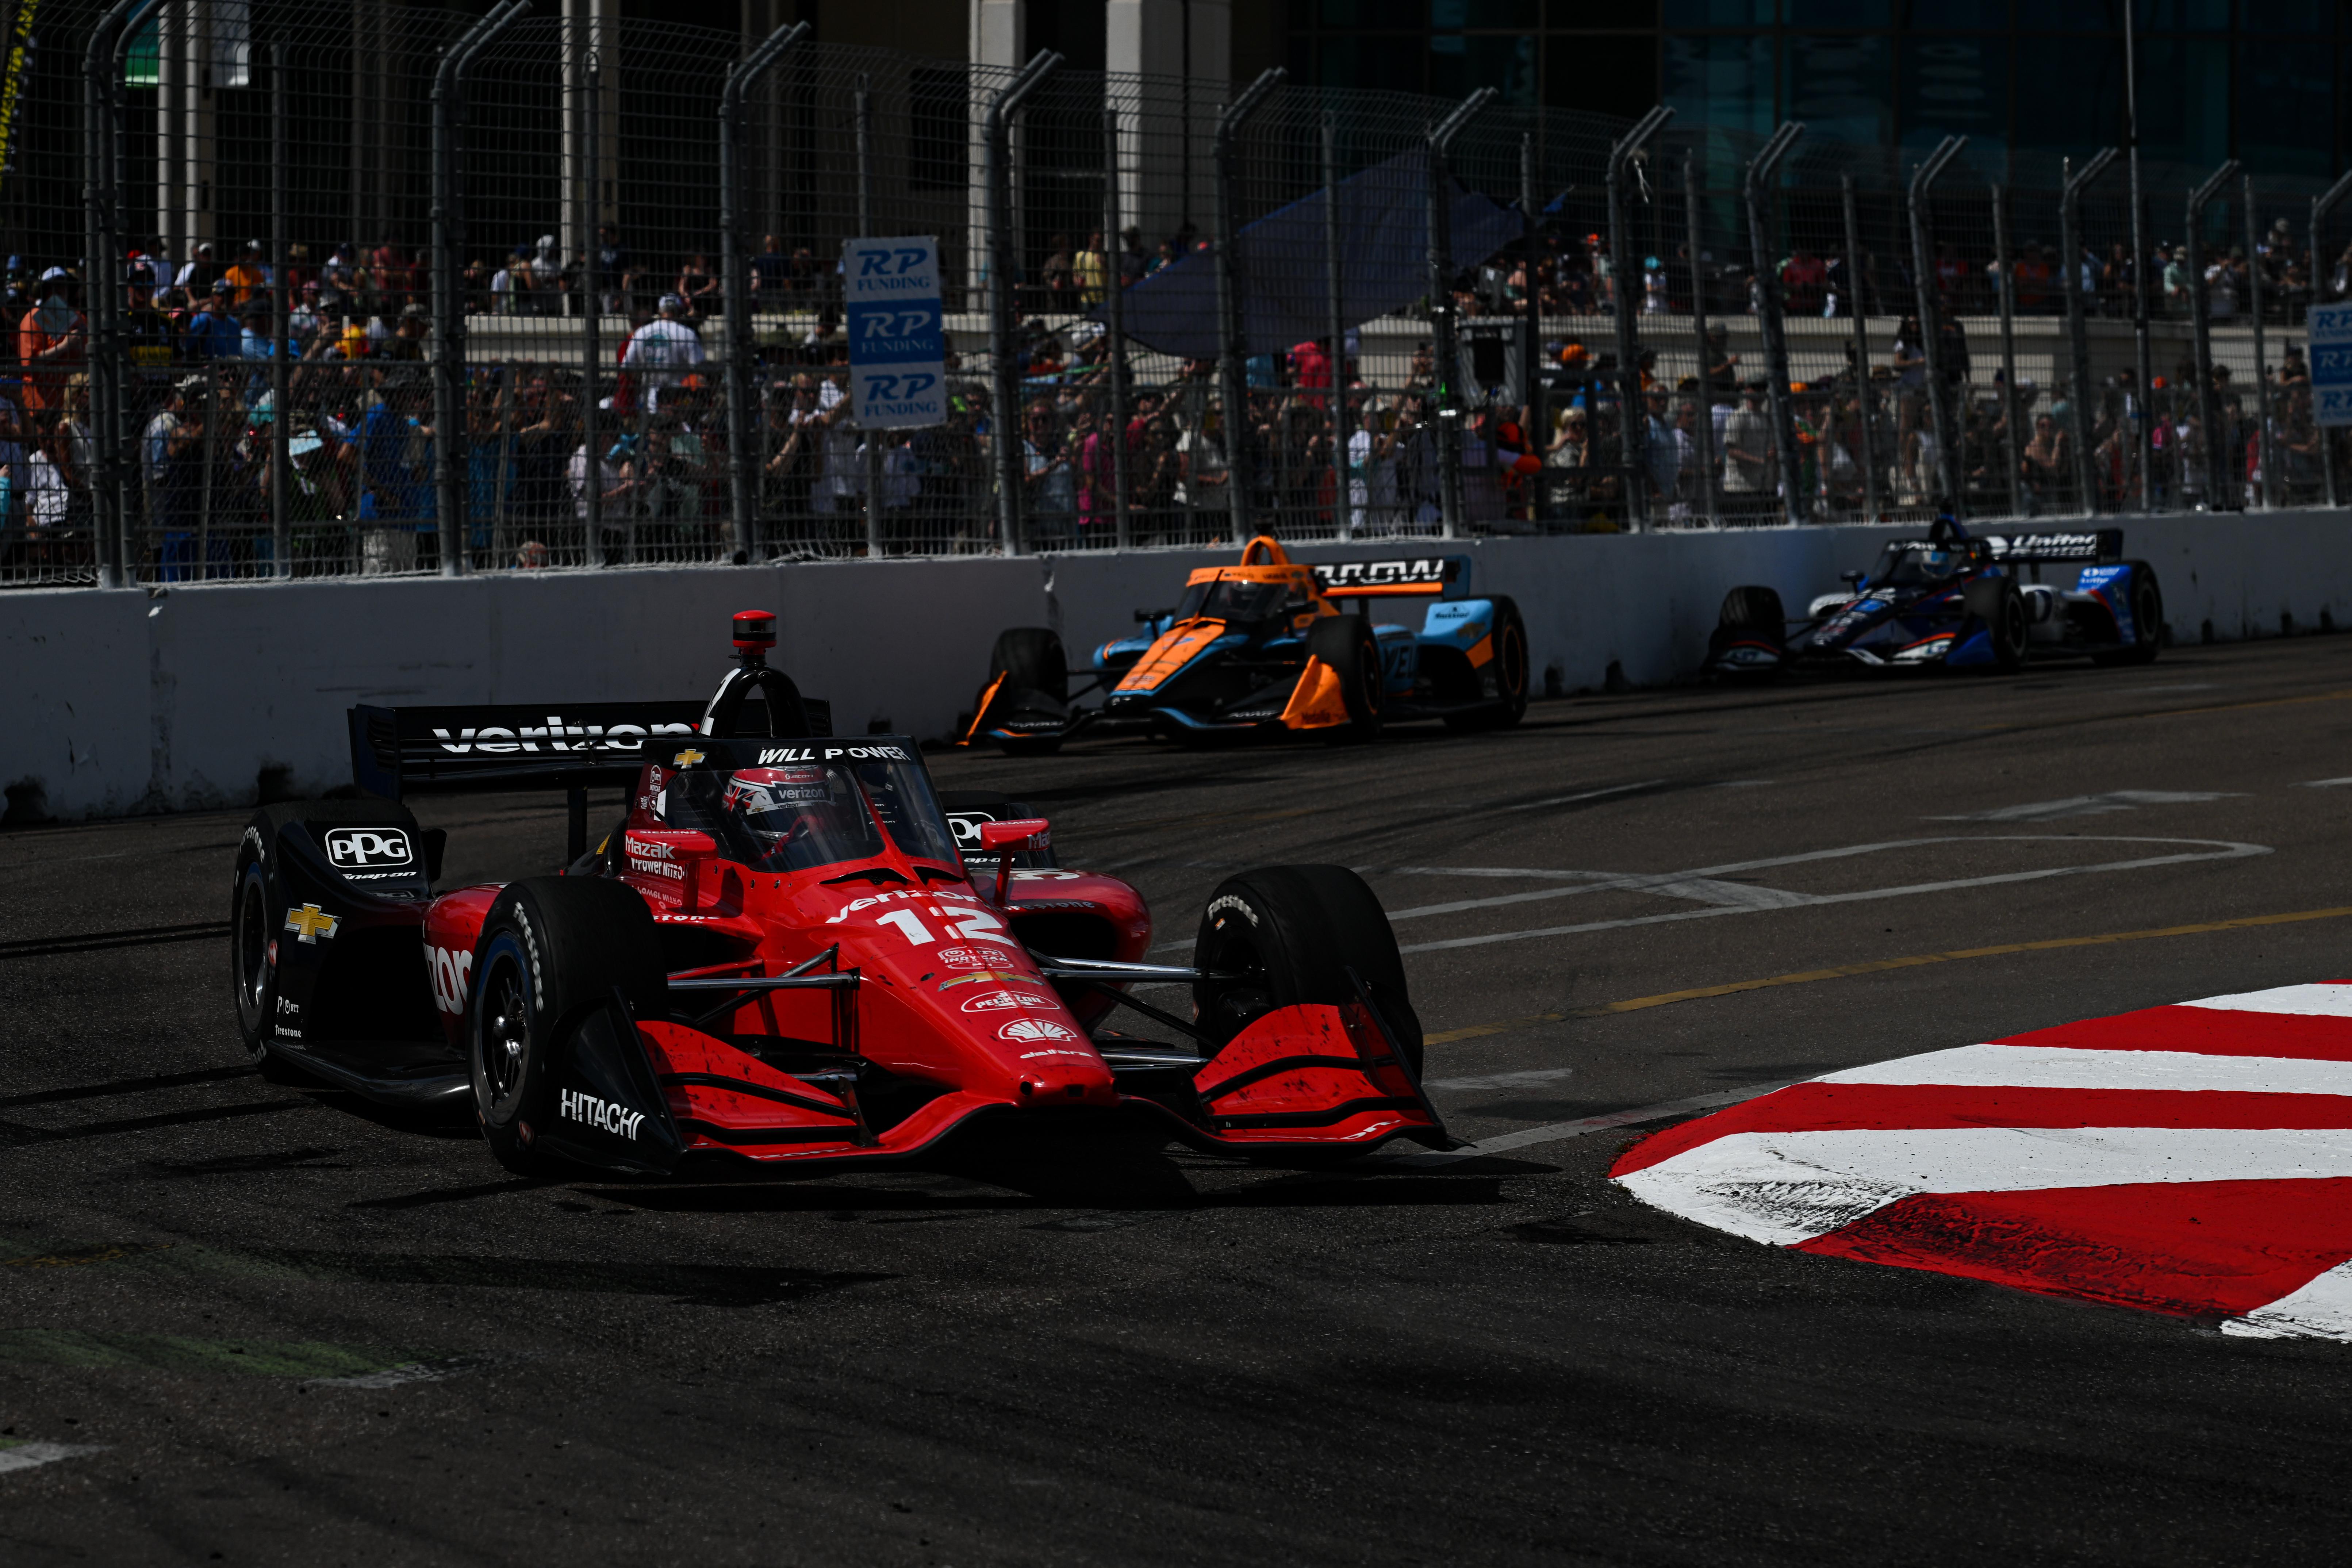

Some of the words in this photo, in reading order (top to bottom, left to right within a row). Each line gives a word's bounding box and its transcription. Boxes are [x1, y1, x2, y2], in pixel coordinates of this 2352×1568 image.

[857, 248, 928, 276] RP
[857, 276, 929, 291] FUNDING
[860, 310, 932, 338] RP
[862, 339, 933, 354] FUNDING
[864, 373, 935, 401] RP
[865, 402, 937, 417] FUNDING
[433, 716, 693, 753] verizon
[757, 748, 816, 764] WILL
[825, 746, 912, 761] POWER
[778, 786, 825, 799] verizon
[331, 833, 406, 863] PPG
[625, 835, 676, 859] Mazak
[825, 890, 993, 924] verizon
[875, 906, 1018, 949] 12
[975, 996, 1045, 1009] PENNZOIL
[275, 1024, 302, 1038] Firestone
[1020, 1049, 1093, 1059] dallara
[561, 1088, 646, 1142] HITACHI
